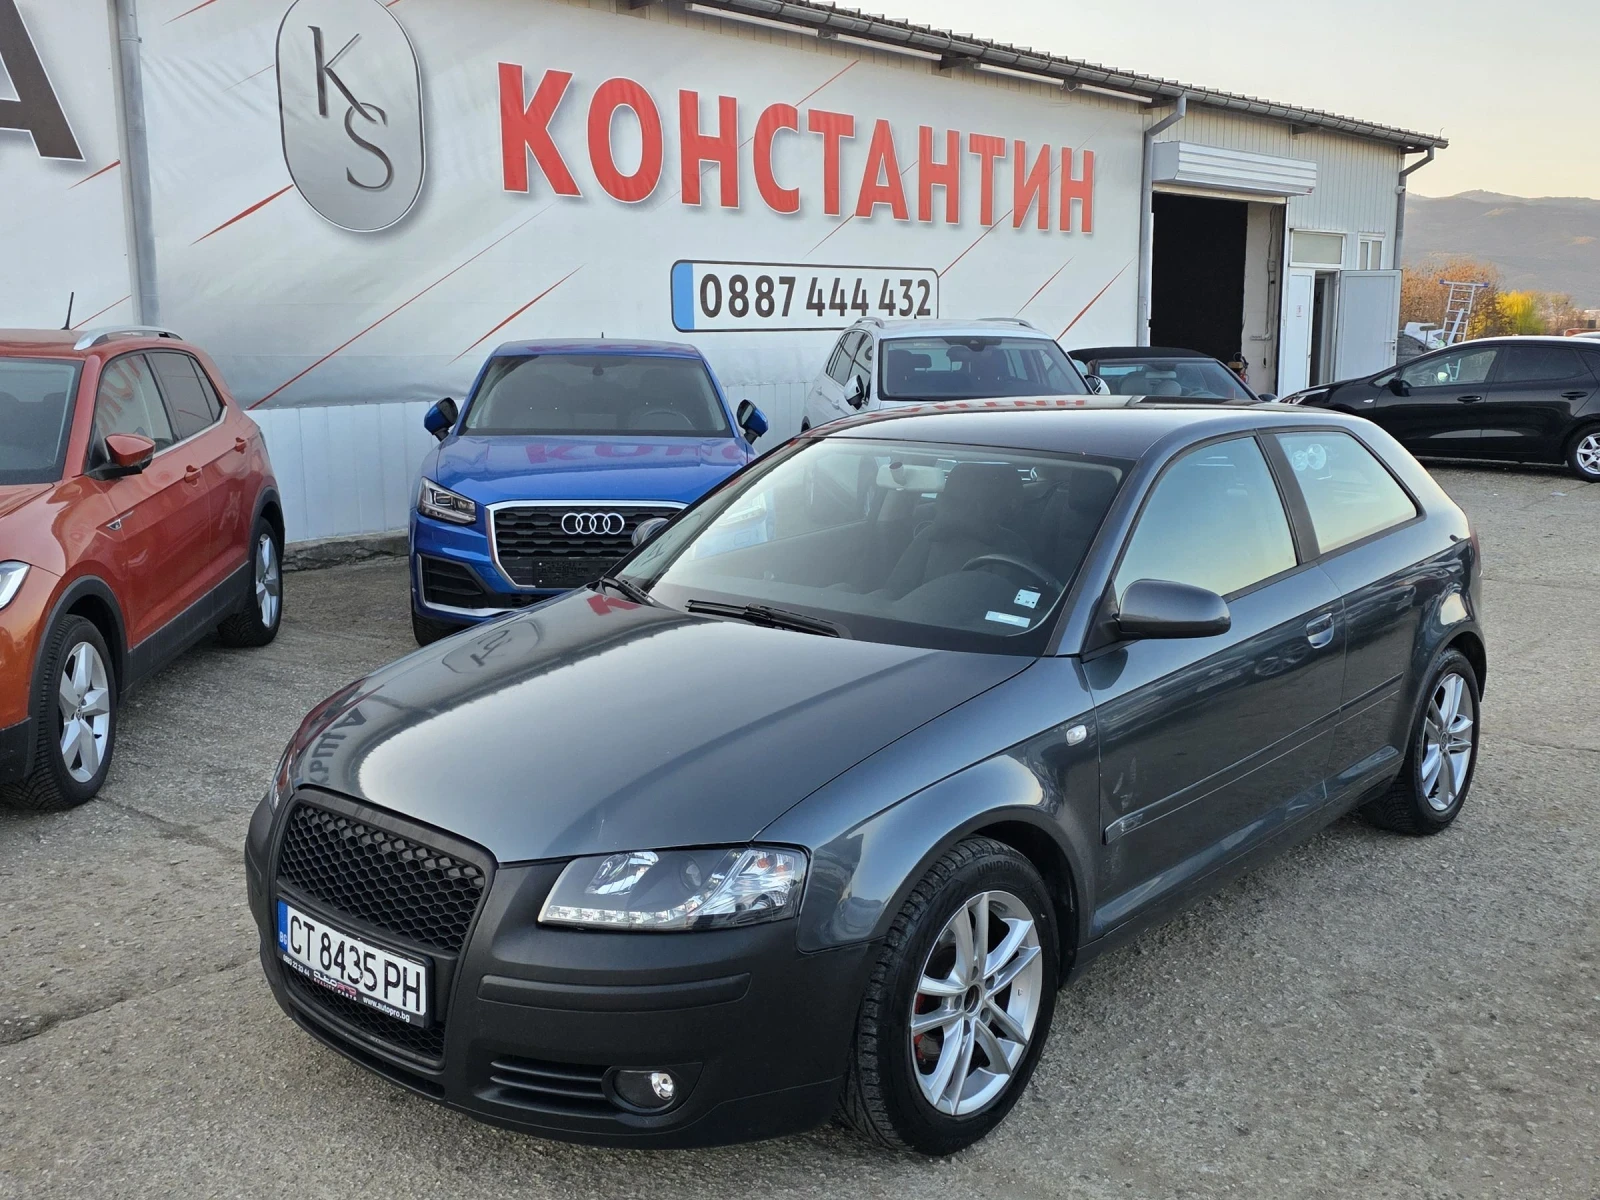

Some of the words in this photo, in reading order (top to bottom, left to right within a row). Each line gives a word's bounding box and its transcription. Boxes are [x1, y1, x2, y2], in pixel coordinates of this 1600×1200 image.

[497, 61, 1095, 235] КОНСТАНТИН
[700, 273, 796, 318] 0887
[806, 276, 869, 317] 444
[878, 278, 931, 317] 432
[279, 931, 288, 945] BG
[290, 915, 315, 962] CT
[319, 932, 378, 992] 8435
[383, 959, 421, 1013] PH
[362, 996, 410, 1023] www.autopro.bg
